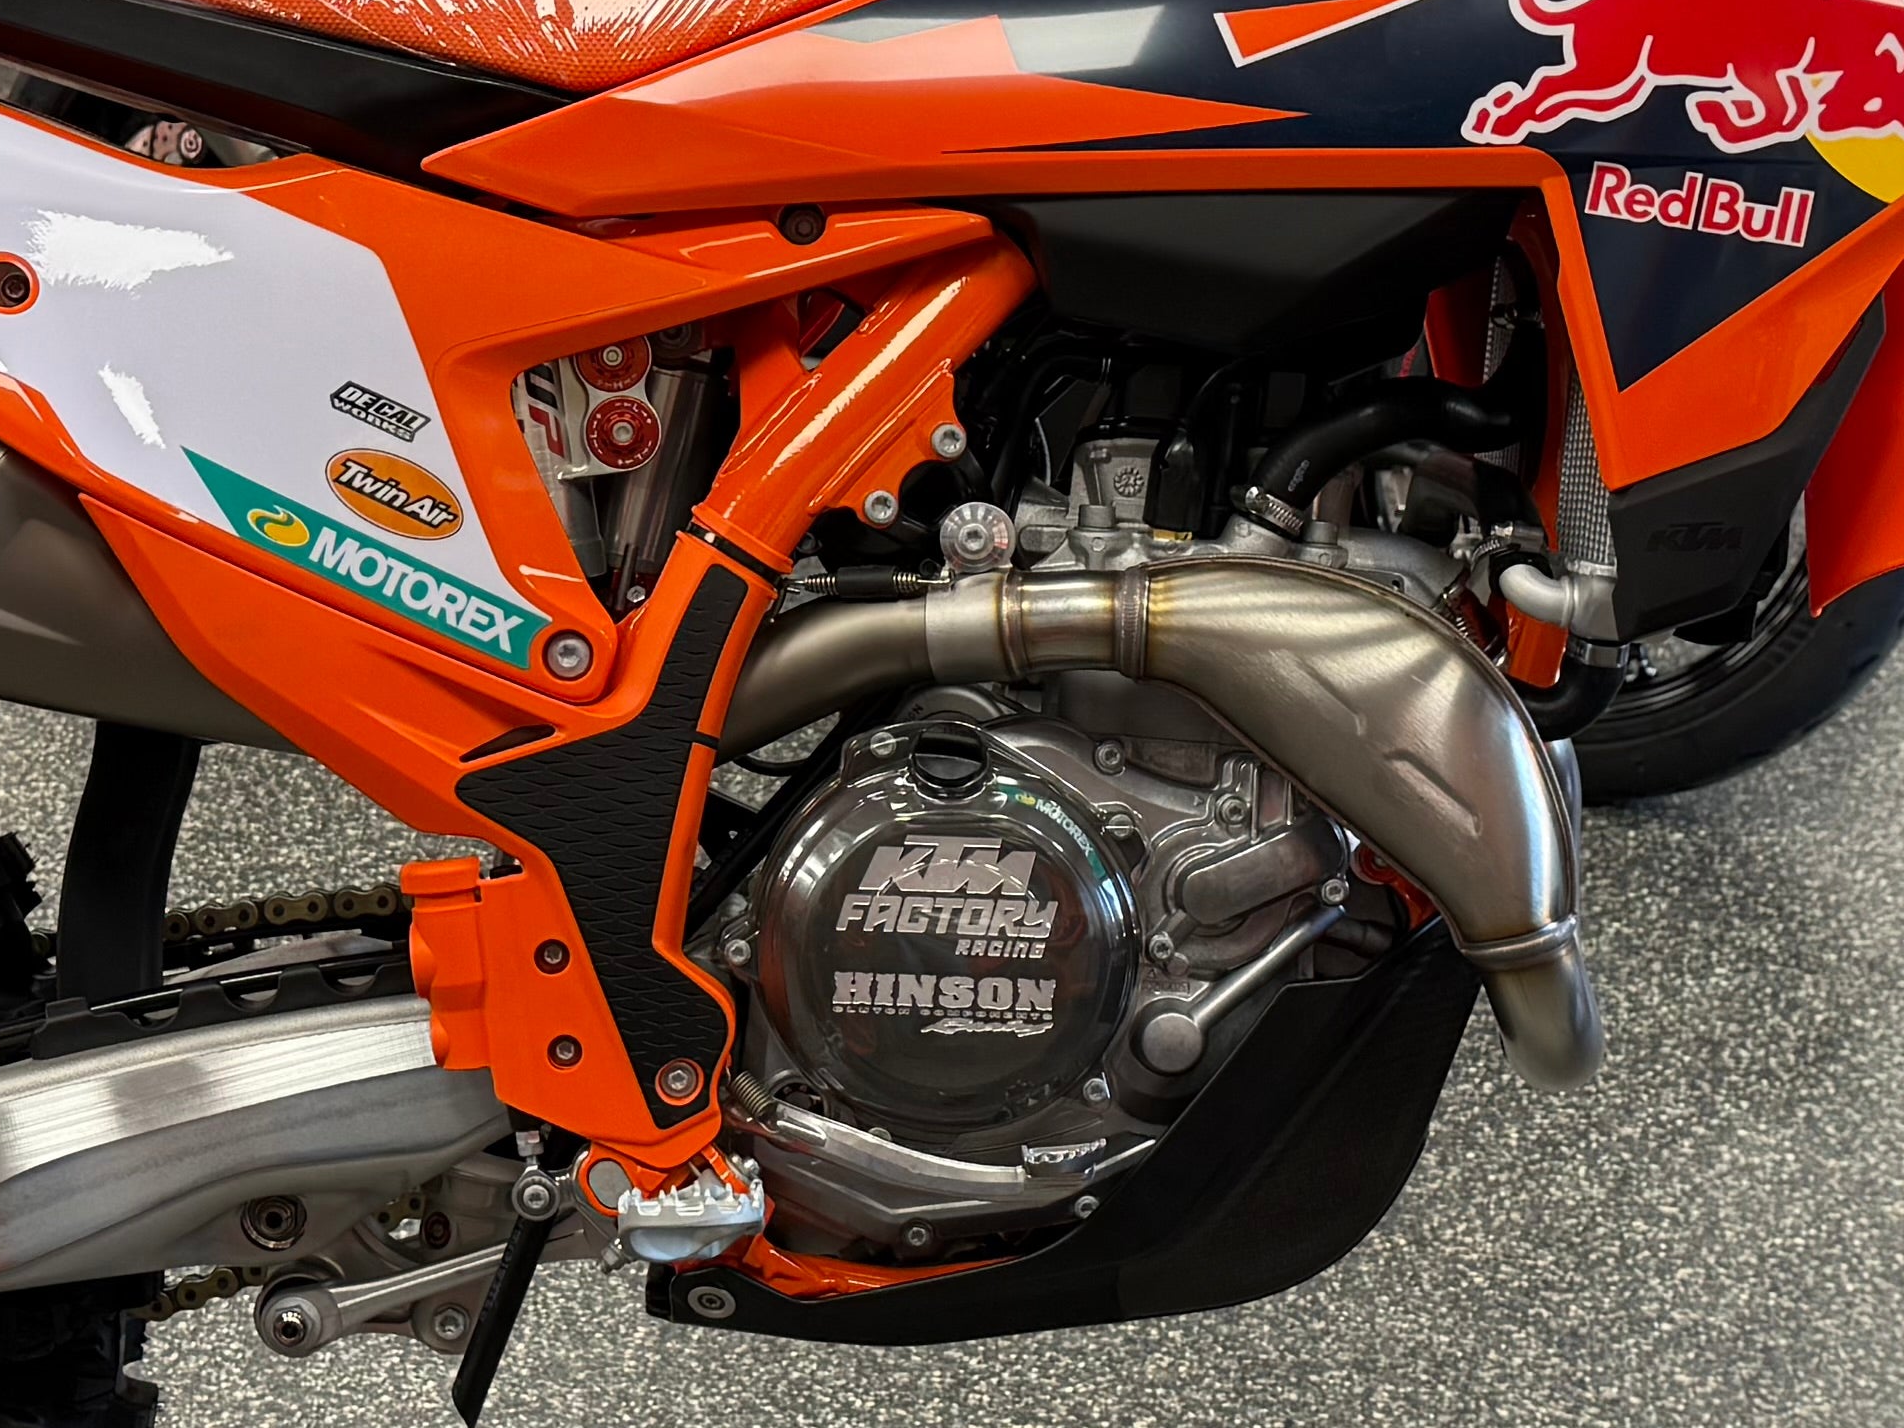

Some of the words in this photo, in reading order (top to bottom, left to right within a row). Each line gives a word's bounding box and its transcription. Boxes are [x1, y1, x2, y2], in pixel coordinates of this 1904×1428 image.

[1585, 161, 1703, 230] Red
[1698, 178, 1815, 248] Bull
[335, 458, 409, 510] Twin
[403, 494, 456, 529] Air
[308, 526, 524, 654] MOTOREX
[1034, 797, 1095, 857] MOTOREX
[858, 833, 1037, 896] KTM
[835, 893, 1059, 939] FACTORY
[954, 938, 1046, 960] RACING
[831, 970, 1057, 1012] HINSON
